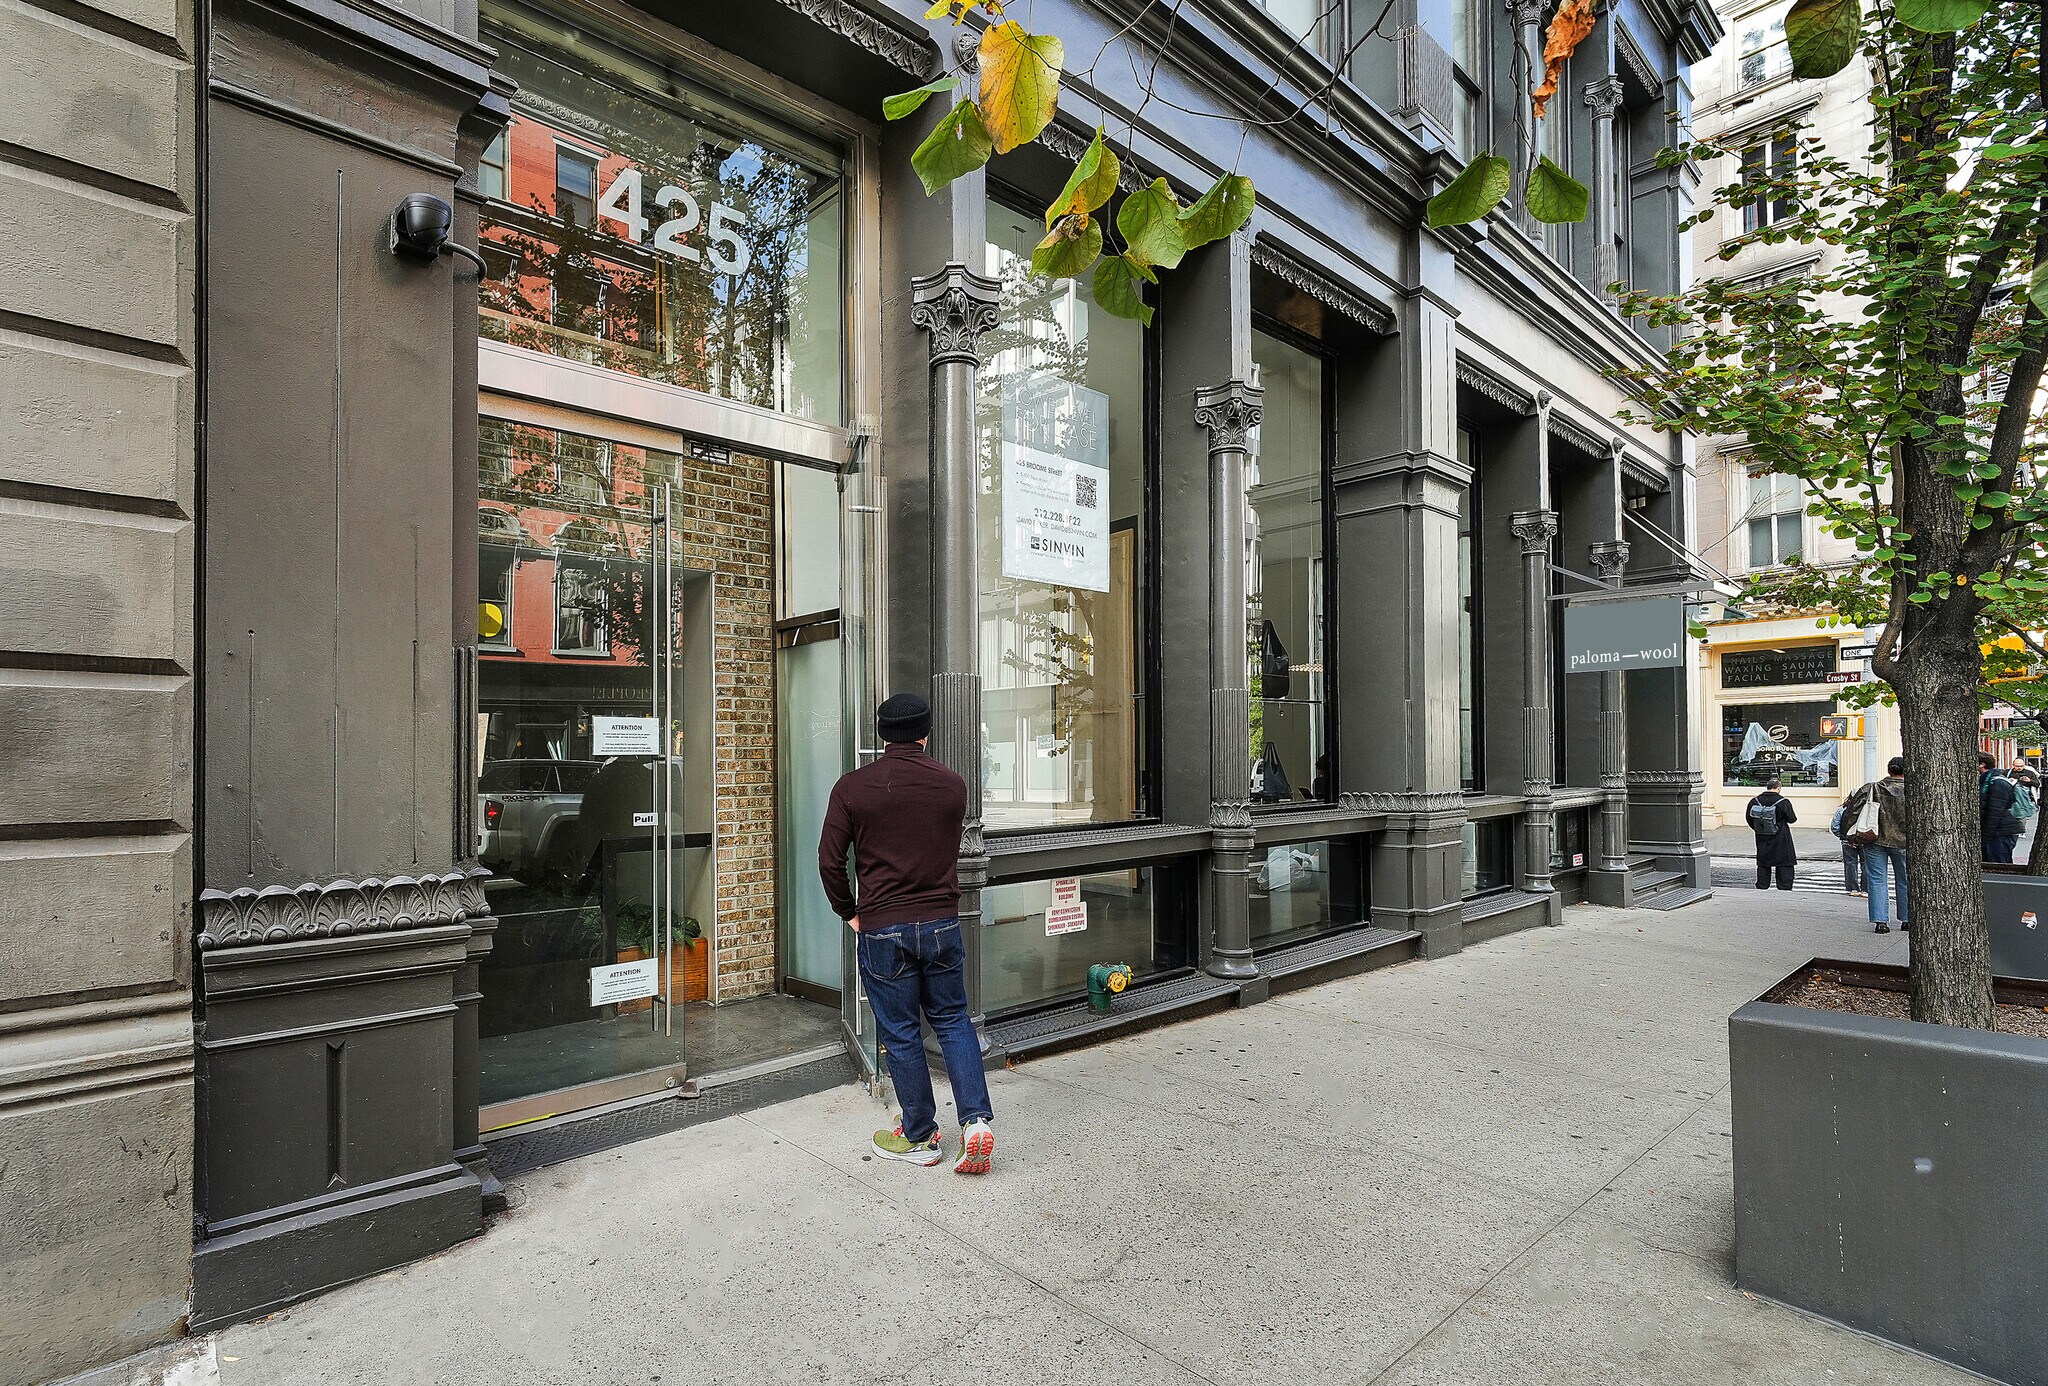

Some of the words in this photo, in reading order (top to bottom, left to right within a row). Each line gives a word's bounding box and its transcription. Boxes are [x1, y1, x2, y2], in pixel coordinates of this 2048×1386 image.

[598, 167, 751, 276] 425
[1026, 460, 1047, 473] BROOME
[1047, 466, 1063, 477] STREET
[1041, 538, 1085, 558] SINVIN
[1730, 655, 1765, 665] NAILS
[1773, 651, 1834, 662] MASSAGE
[1845, 649, 1861, 657] ONE
[1724, 664, 1772, 674] WAXING
[1782, 661, 1825, 671] SAUNA
[1727, 674, 1769, 683] FACIAL
[1782, 670, 1824, 680] STEAM
[1826, 673, 1849, 683] Crosby
[1850, 673, 1859, 682] St
[1764, 753, 1793, 761] SPA
[634, 815, 654, 824] Pull
[609, 968, 641, 979] ATTENTION
